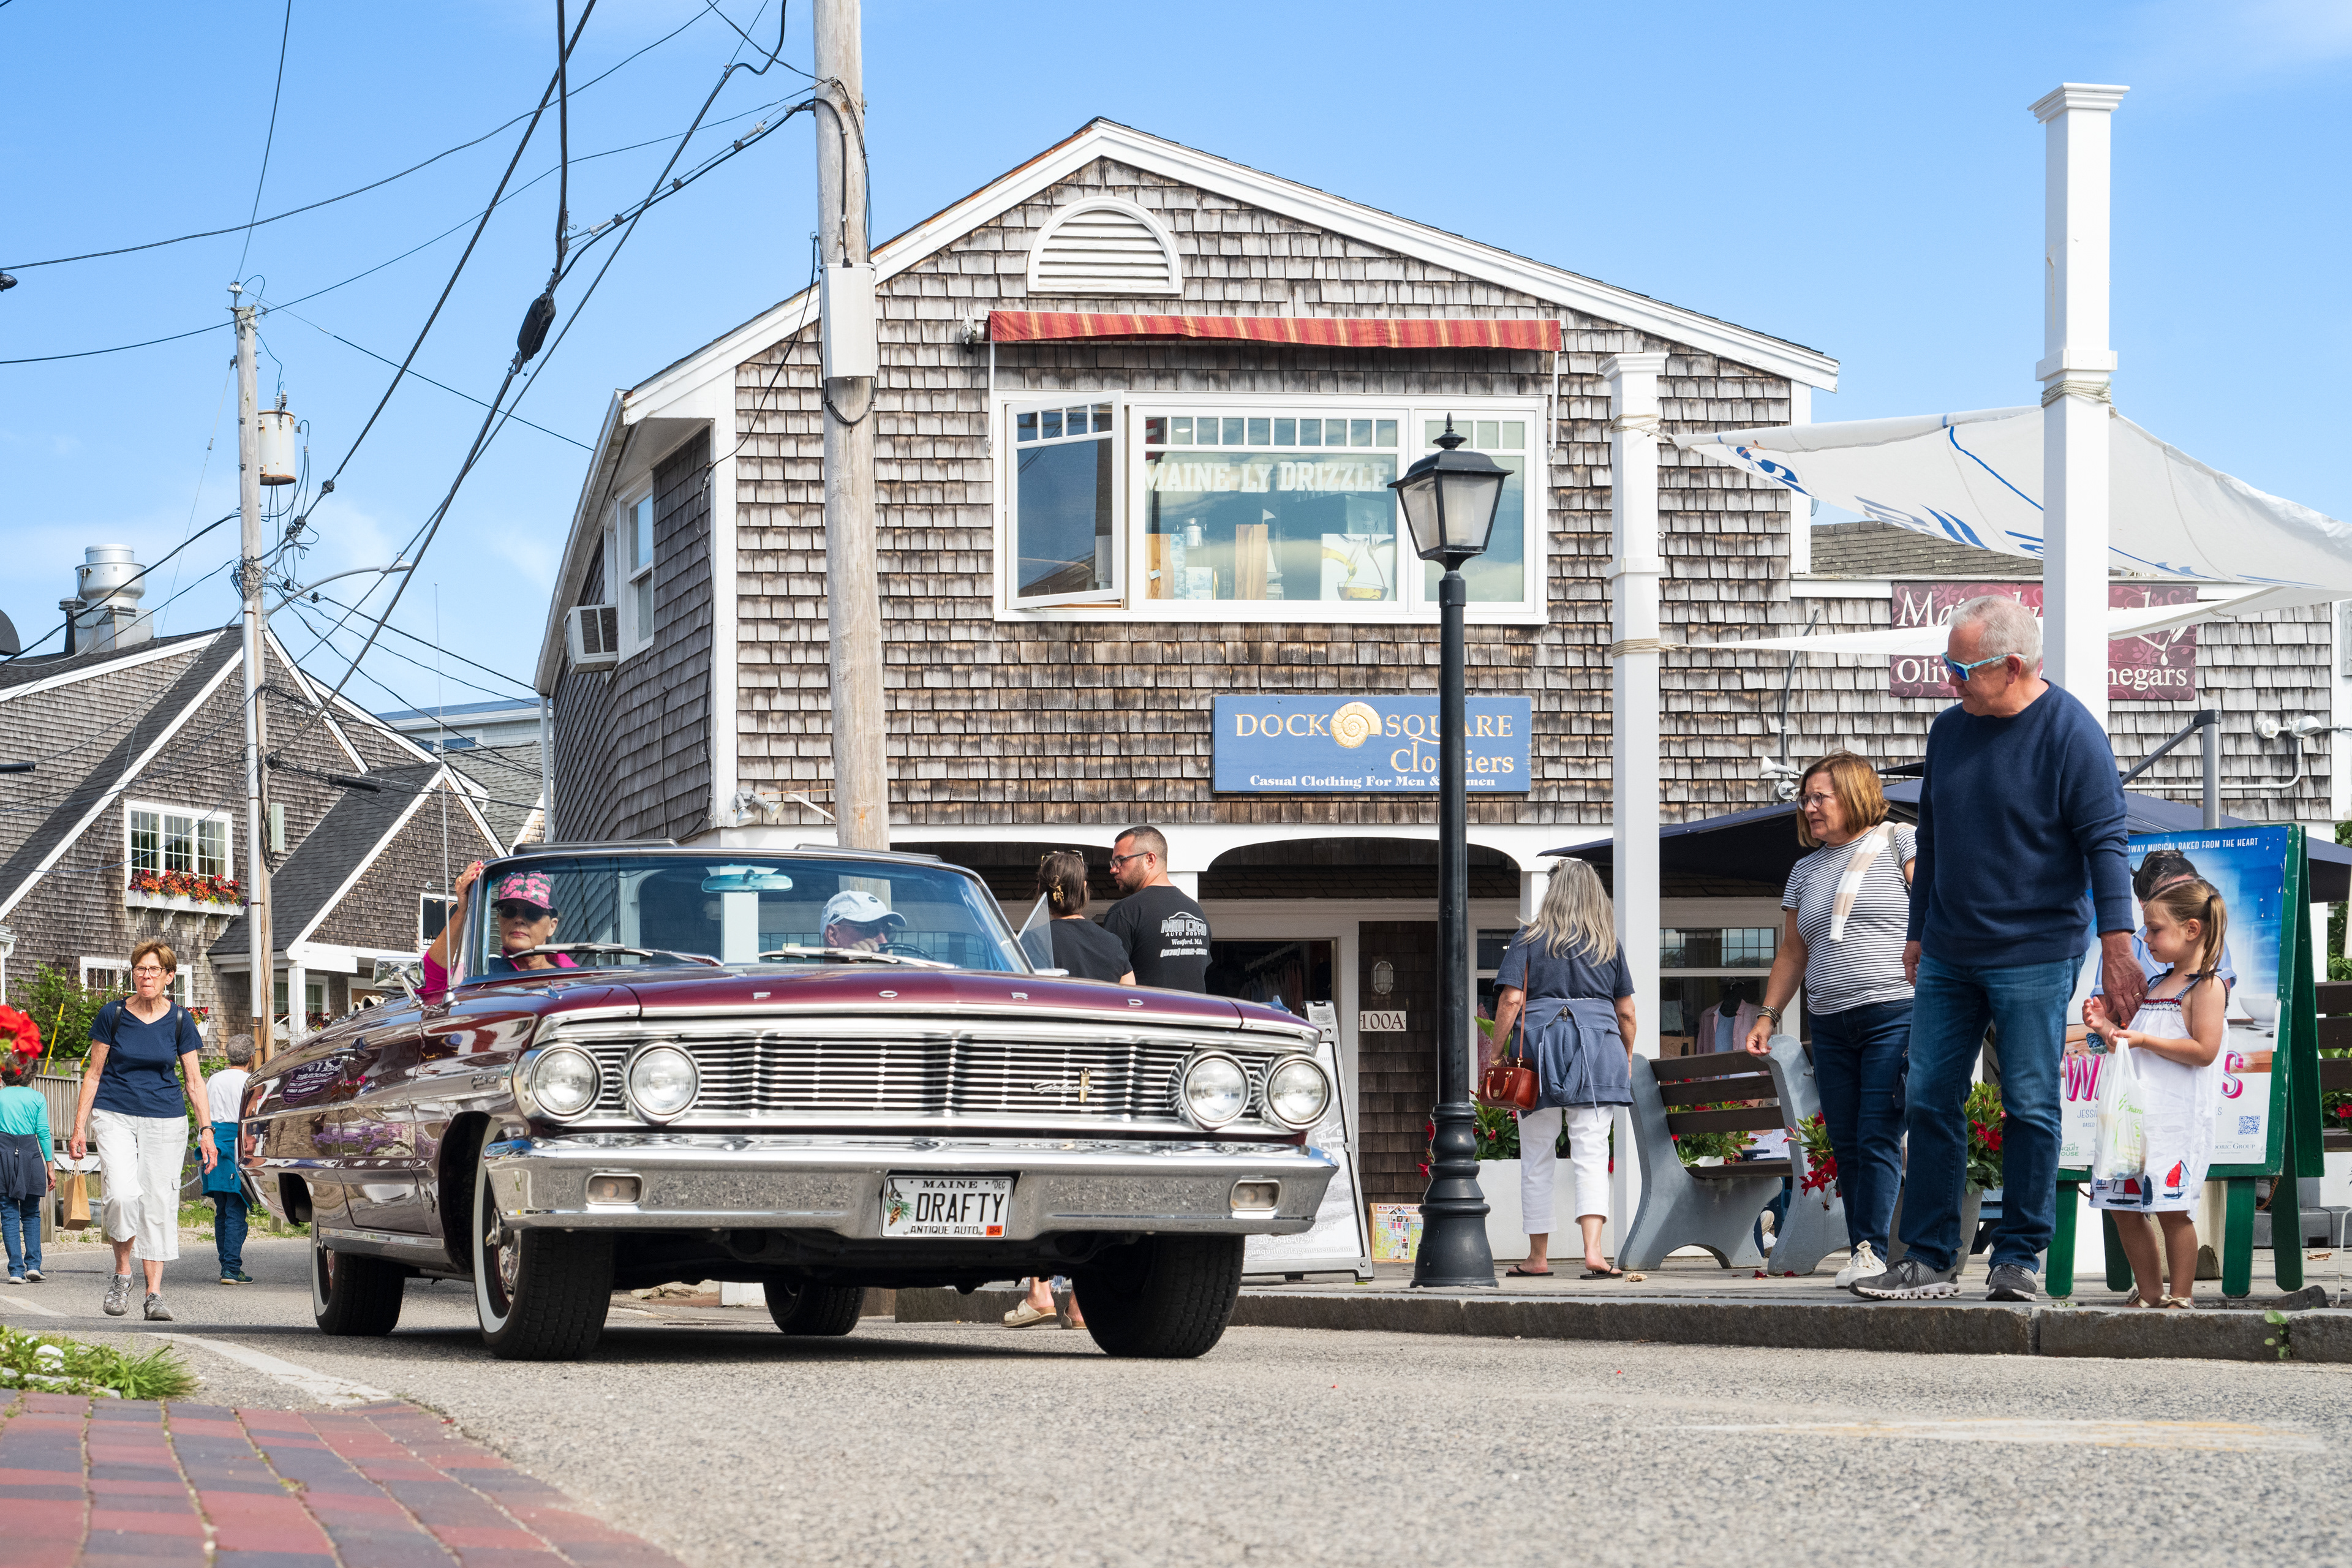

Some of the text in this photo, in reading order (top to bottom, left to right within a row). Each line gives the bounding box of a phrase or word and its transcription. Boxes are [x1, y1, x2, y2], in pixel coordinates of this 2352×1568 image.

[1145, 462, 1389, 492] MAINE-LY DRIZZLE
[1897, 658, 1952, 684] Oliv
[2108, 668, 2187, 691] negars
[1235, 714, 1330, 737] DOCK
[1390, 741, 1514, 773] Cloiers
[1250, 775, 1297, 786] Casual
[1301, 775, 1362, 789] Clothing
[1366, 775, 1392, 786] For
[1395, 775, 1425, 786] Men
[1429, 775, 1440, 786] &
[2147, 842, 2176, 852] MUSICAL
[2178, 841, 2199, 850] BAKED
[2202, 840, 2220, 849] FROM
[2223, 839, 2234, 848] THE
[2237, 838, 2258, 846] HEART
[1161, 919, 1207, 936] Mill City
[1361, 1012, 1405, 1029] 100A
[992, 1180, 1006, 1189] DEC
[916, 1193, 1005, 1223] DRAFTY
[910, 1226, 949, 1234] ANTIQUE
[1259, 1235, 1314, 1245] 207-646-0296
